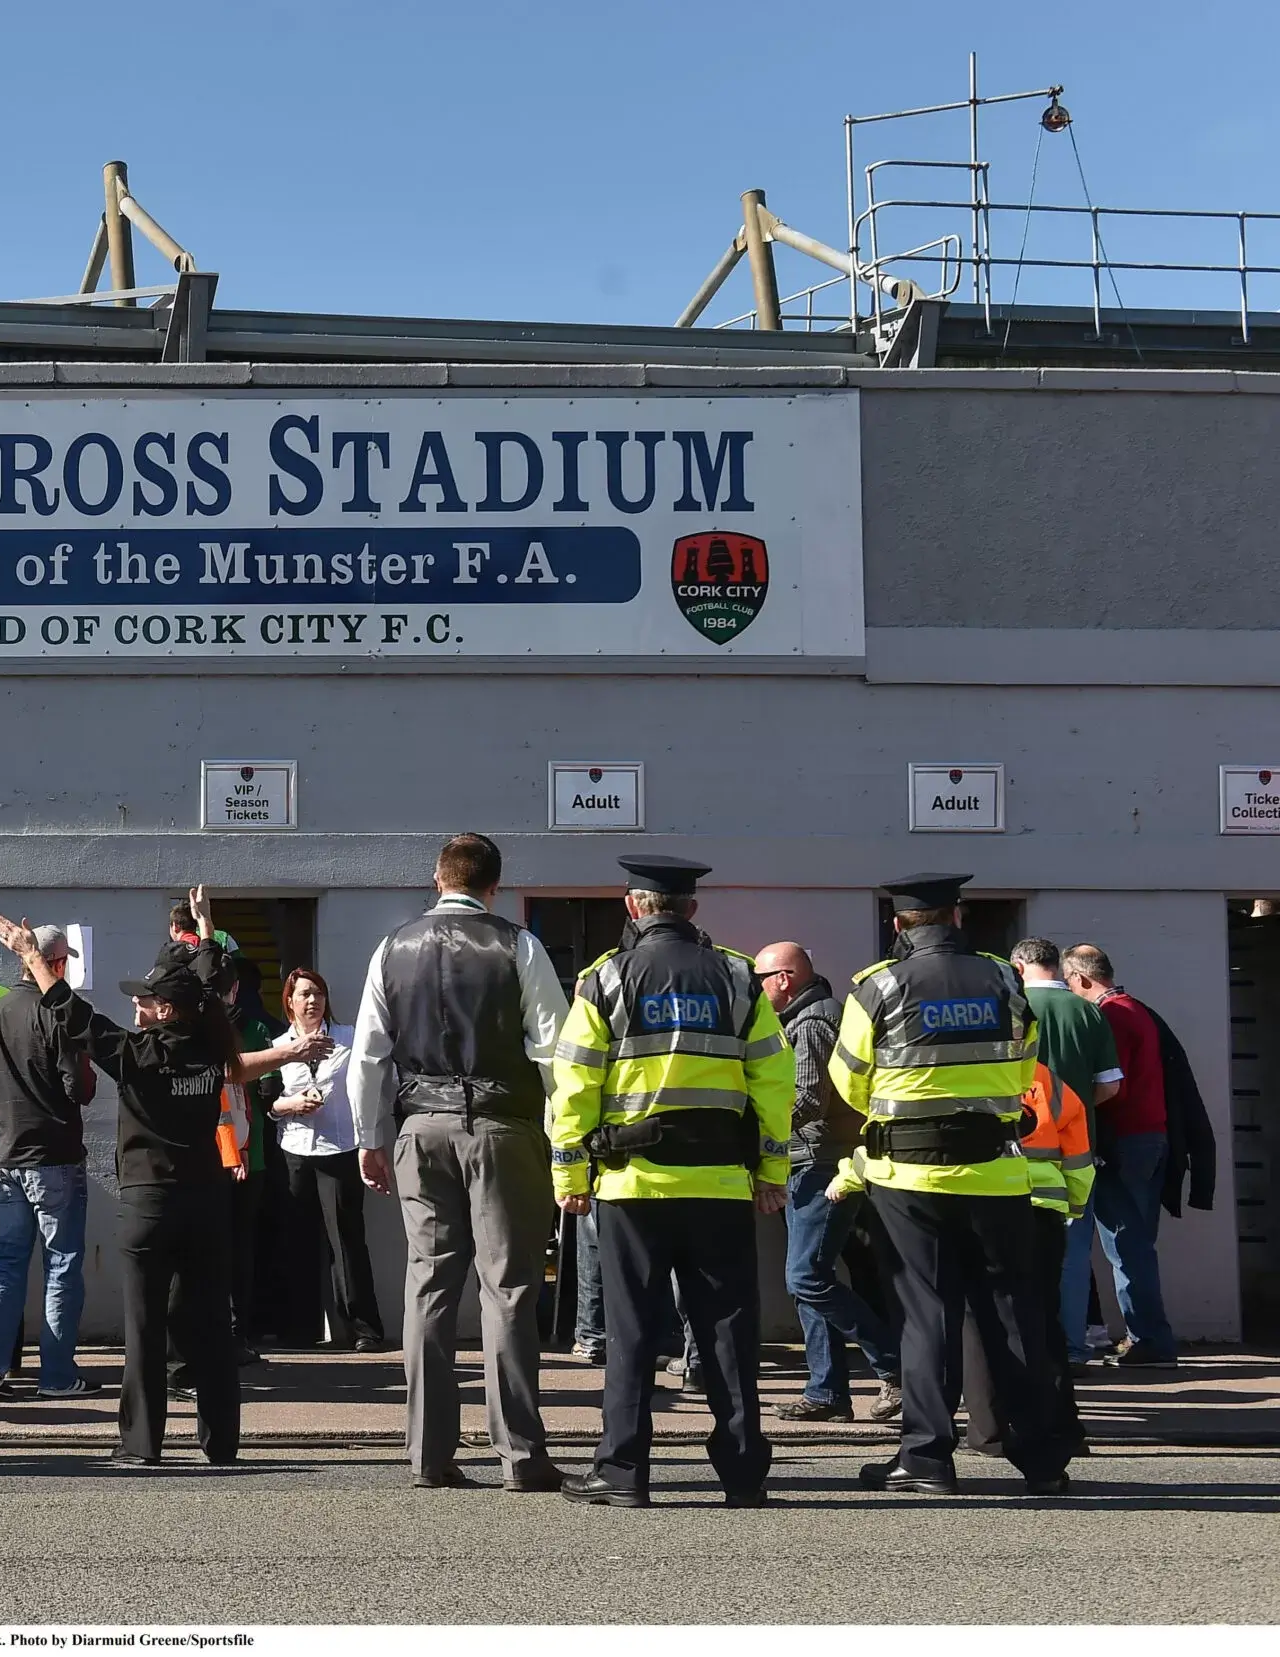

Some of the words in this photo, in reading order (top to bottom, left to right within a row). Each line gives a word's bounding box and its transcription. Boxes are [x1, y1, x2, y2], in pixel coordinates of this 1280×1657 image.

[269, 414, 754, 516] STADIUM
[15, 543, 74, 586] of
[93, 542, 181, 585] the
[198, 542, 435, 586] Munster
[453, 541, 577, 584] F.A.
[677, 585, 722, 597] CORK
[726, 585, 762, 598] CITY
[686, 601, 729, 615] FOOTBALL
[732, 603, 754, 616] CLUB
[40, 615, 101, 645] OF
[114, 614, 247, 645] CORK
[260, 614, 368, 645] CITY
[380, 613, 464, 644] F.C.
[703, 617, 737, 629] 1984
[234, 784, 255, 796] VIP
[225, 797, 269, 808] Season
[571, 794, 621, 809] Adult
[931, 795, 980, 811] Adult
[1244, 792, 1280, 805] Ticke
[225, 809, 269, 821] Tickets
[1231, 806, 1280, 819] Collecti
[644, 998, 713, 1024] GARDA
[923, 1002, 997, 1029] GARDA
[171, 1075, 215, 1096] SECURITY
